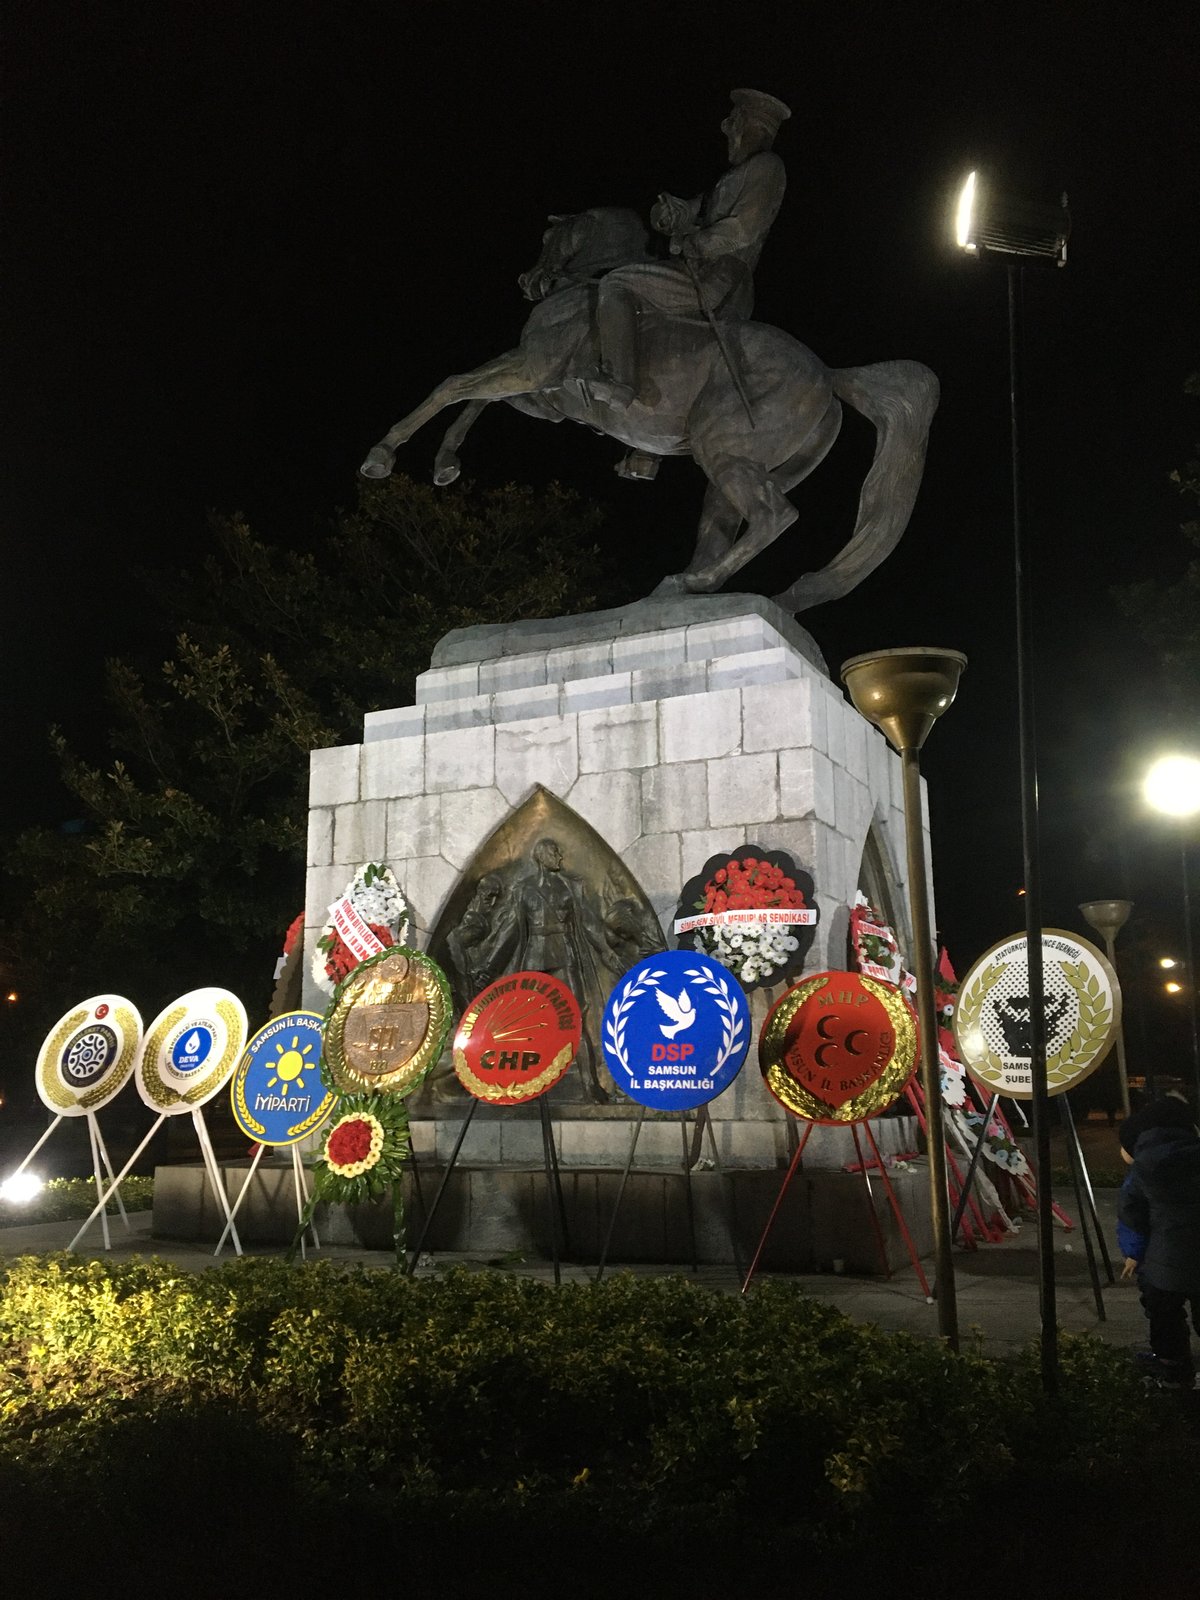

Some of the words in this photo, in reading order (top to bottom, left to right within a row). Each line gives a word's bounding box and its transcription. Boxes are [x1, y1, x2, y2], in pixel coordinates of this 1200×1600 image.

[772, 912, 809, 924] SENDİKASI
[1055, 941, 1083, 960] DERNEĞİ
[817, 991, 868, 1008] MHP
[251, 1022, 286, 1054] SAMSUN
[286, 1017, 296, 1028] İL
[296, 1017, 323, 1035] BAŞKA
[652, 1043, 694, 1062] DSP
[178, 1055, 199, 1064] DEVA
[480, 1049, 541, 1071] CHP
[1003, 1062, 1032, 1070] SAMS
[648, 1065, 697, 1075] SAMSUN
[630, 1078, 641, 1089] İL
[643, 1078, 714, 1091] BAŞKANLIĞI
[1005, 1075, 1031, 1084] ŞUBE
